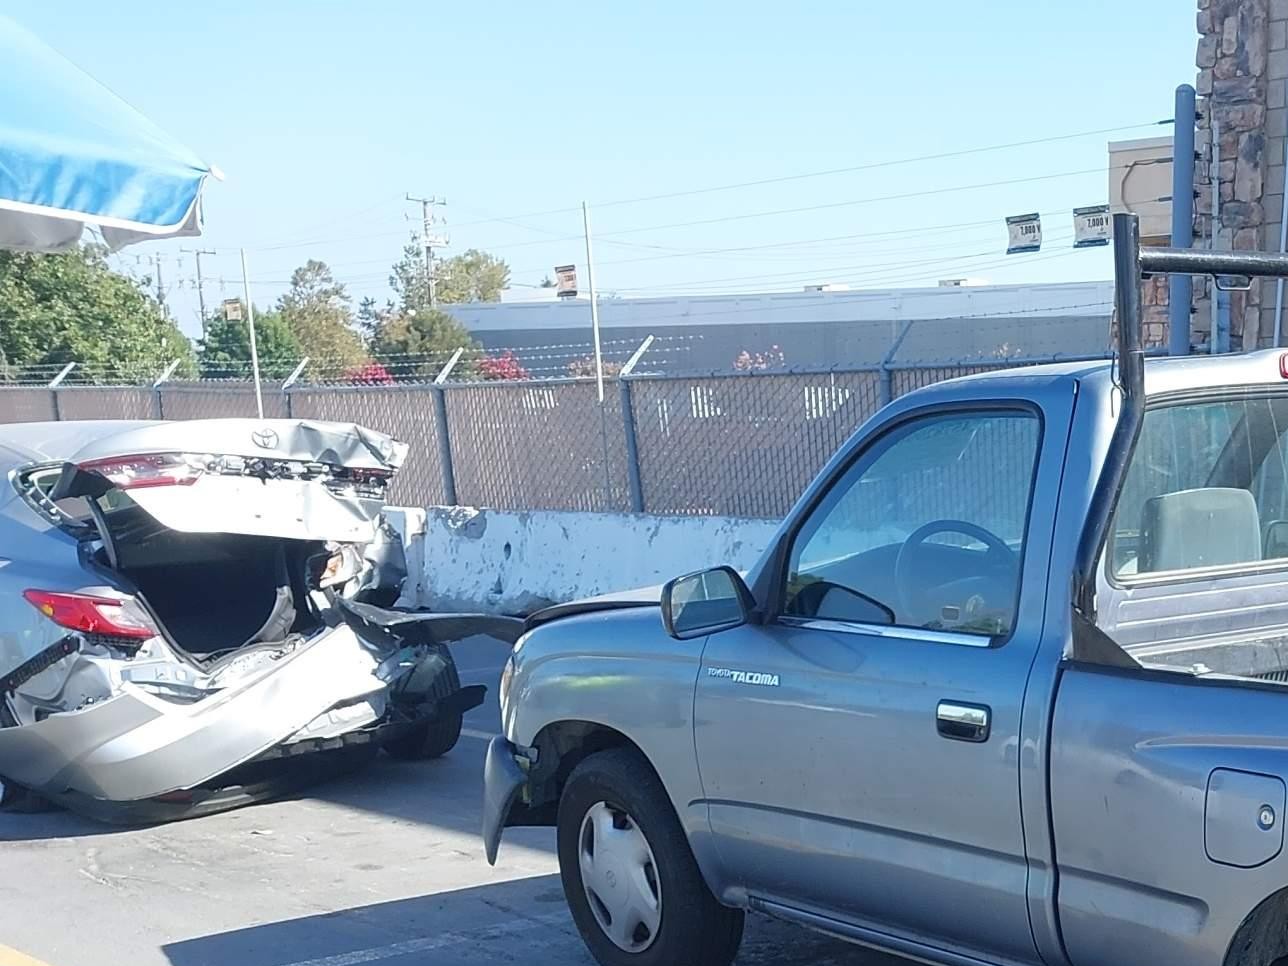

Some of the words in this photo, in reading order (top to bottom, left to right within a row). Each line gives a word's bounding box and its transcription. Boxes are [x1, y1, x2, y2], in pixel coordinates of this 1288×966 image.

[1087, 217, 1104, 229] 7,000
[708, 667, 731, 678] TOYOTA
[730, 670, 779, 687] TACOMA
